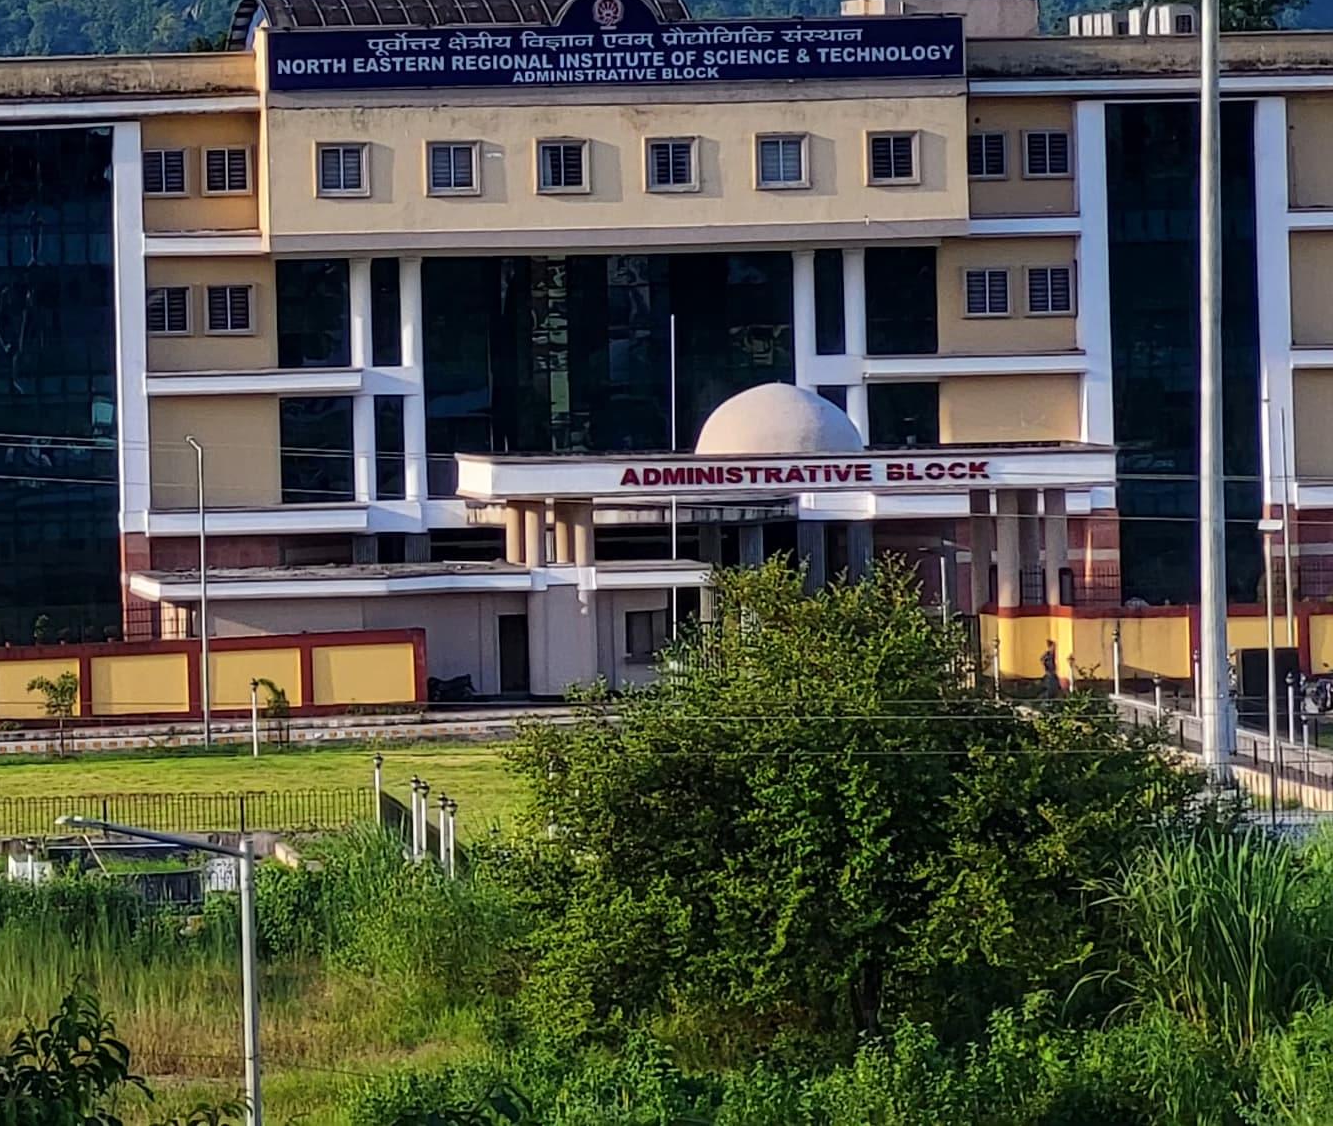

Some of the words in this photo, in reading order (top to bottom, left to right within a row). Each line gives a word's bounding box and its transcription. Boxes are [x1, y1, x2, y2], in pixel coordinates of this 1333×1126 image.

[448, 31, 513, 50] क्षेत्रीय
[519, 30, 595, 51] विज्ञान
[602, 33, 655, 49] एवम्
[780, 25, 863, 42] संस्थान
[277, 58, 347, 75] NORTH
[353, 55, 445, 73] EASTERN
[451, 53, 553, 71] REGIONAL
[559, 51, 665, 68] INSTITUTE
[671, 50, 697, 66] OF
[703, 48, 790, 65] SCIENCE
[796, 47, 811, 64] &
[817, 44, 955, 63] TECHNOLOGY
[512, 67, 657, 83] ADMINISTRATIVE
[661, 66, 720, 80] BLOCK
[620, 463, 873, 486] ADMINISTRATIVE
[885, 461, 991, 482] BLOCK
